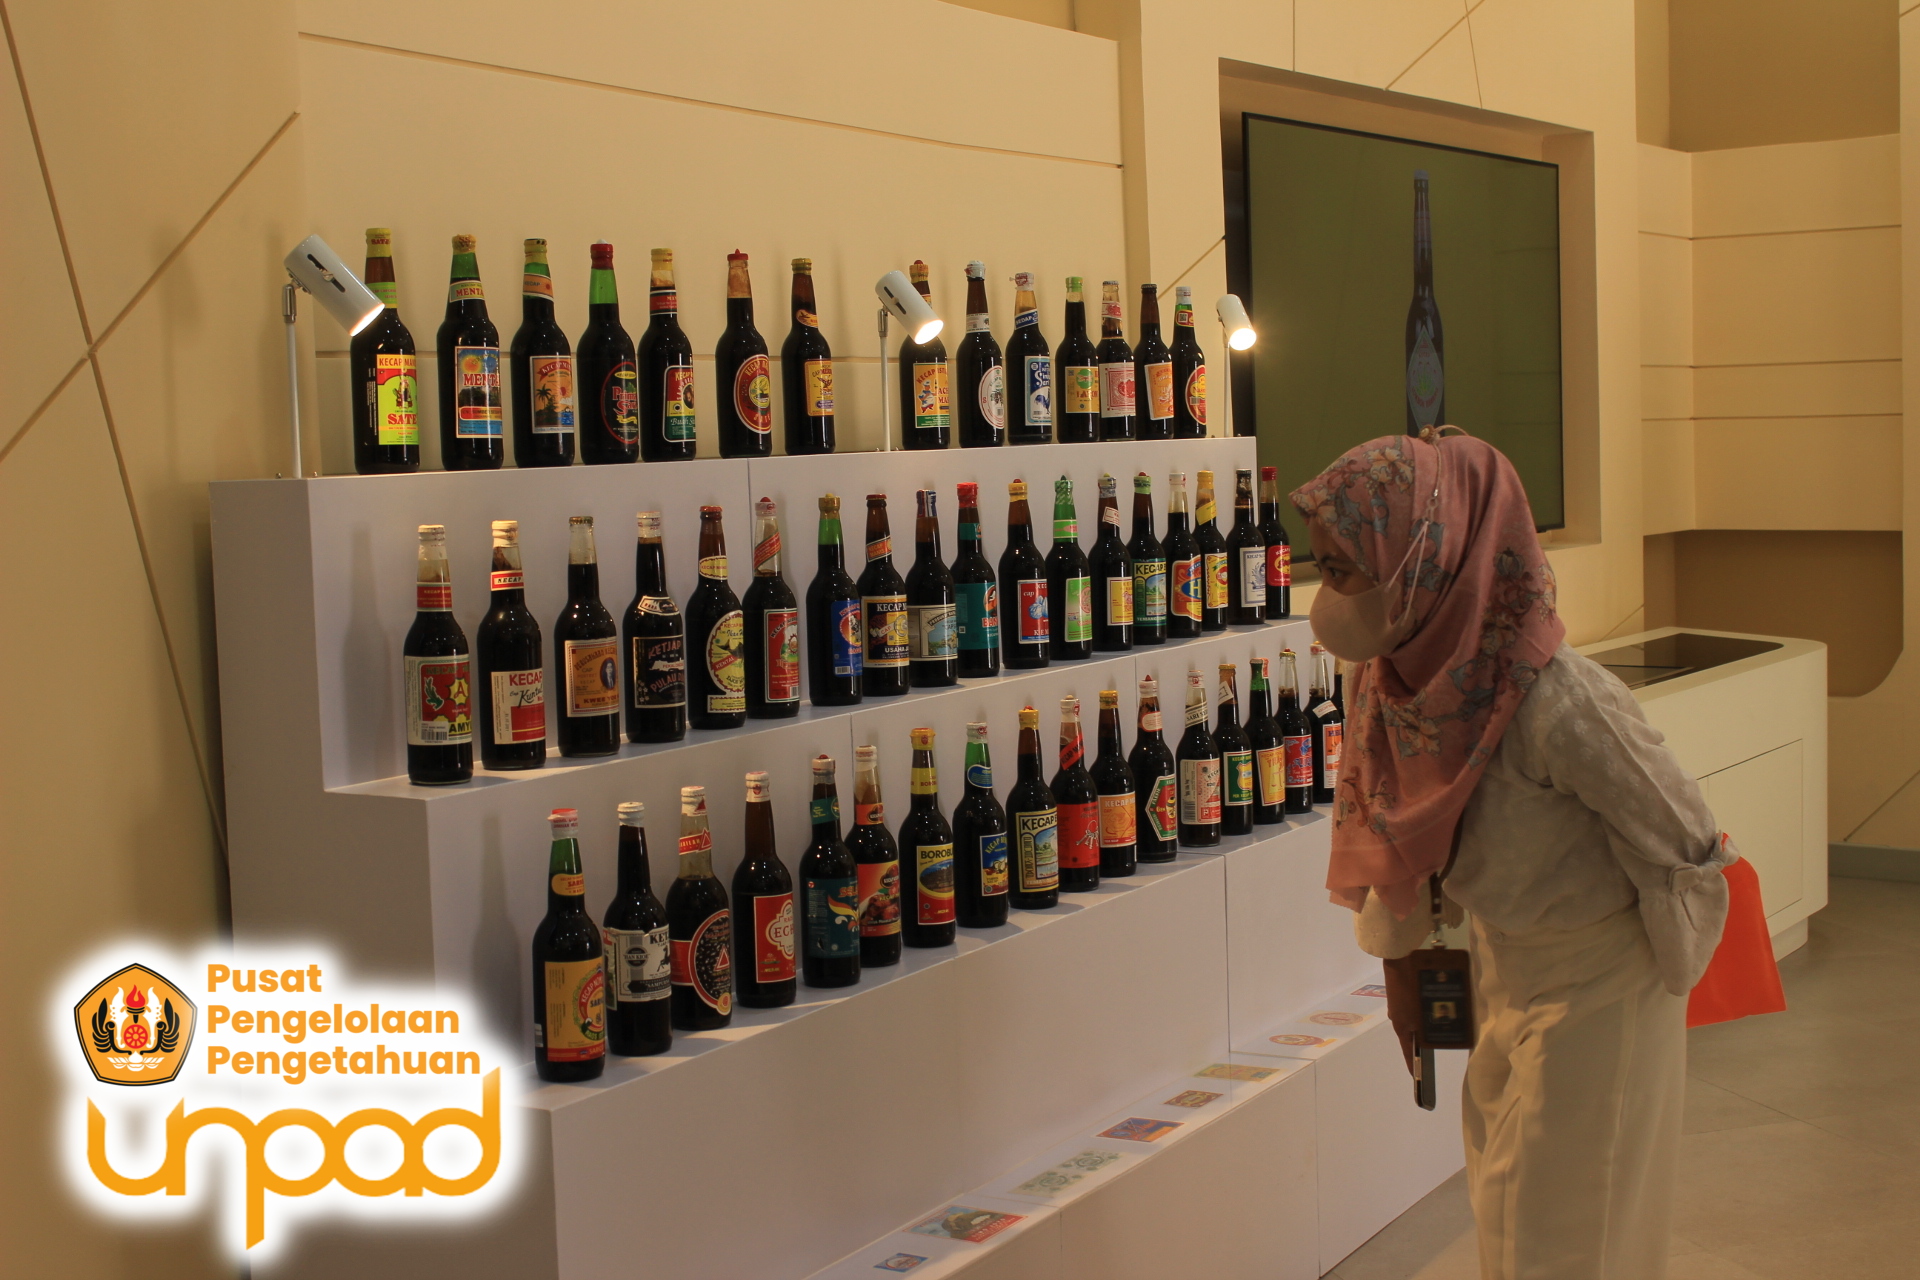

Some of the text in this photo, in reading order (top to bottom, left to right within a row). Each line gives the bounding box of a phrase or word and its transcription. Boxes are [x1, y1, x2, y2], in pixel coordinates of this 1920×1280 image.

[379, 357, 402, 367] KECAP
[917, 367, 936, 384] KECAP
[387, 413, 417, 425] SATE
[1135, 564, 1162, 575] KECAP
[497, 576, 522, 584] KECAP
[877, 603, 903, 612] KECAP
[880, 626, 893, 635] CAP
[648, 640, 682, 659] KETJAP
[715, 656, 735, 669] KENTAL
[425, 664, 459, 675] KECAP
[509, 670, 543, 687] KECAP
[649, 674, 677, 693] PULAU
[454, 681, 468, 700] A
[1104, 798, 1131, 807] KECAP
[1021, 815, 1055, 831] KECAP
[581, 986, 595, 1003] KECAP
